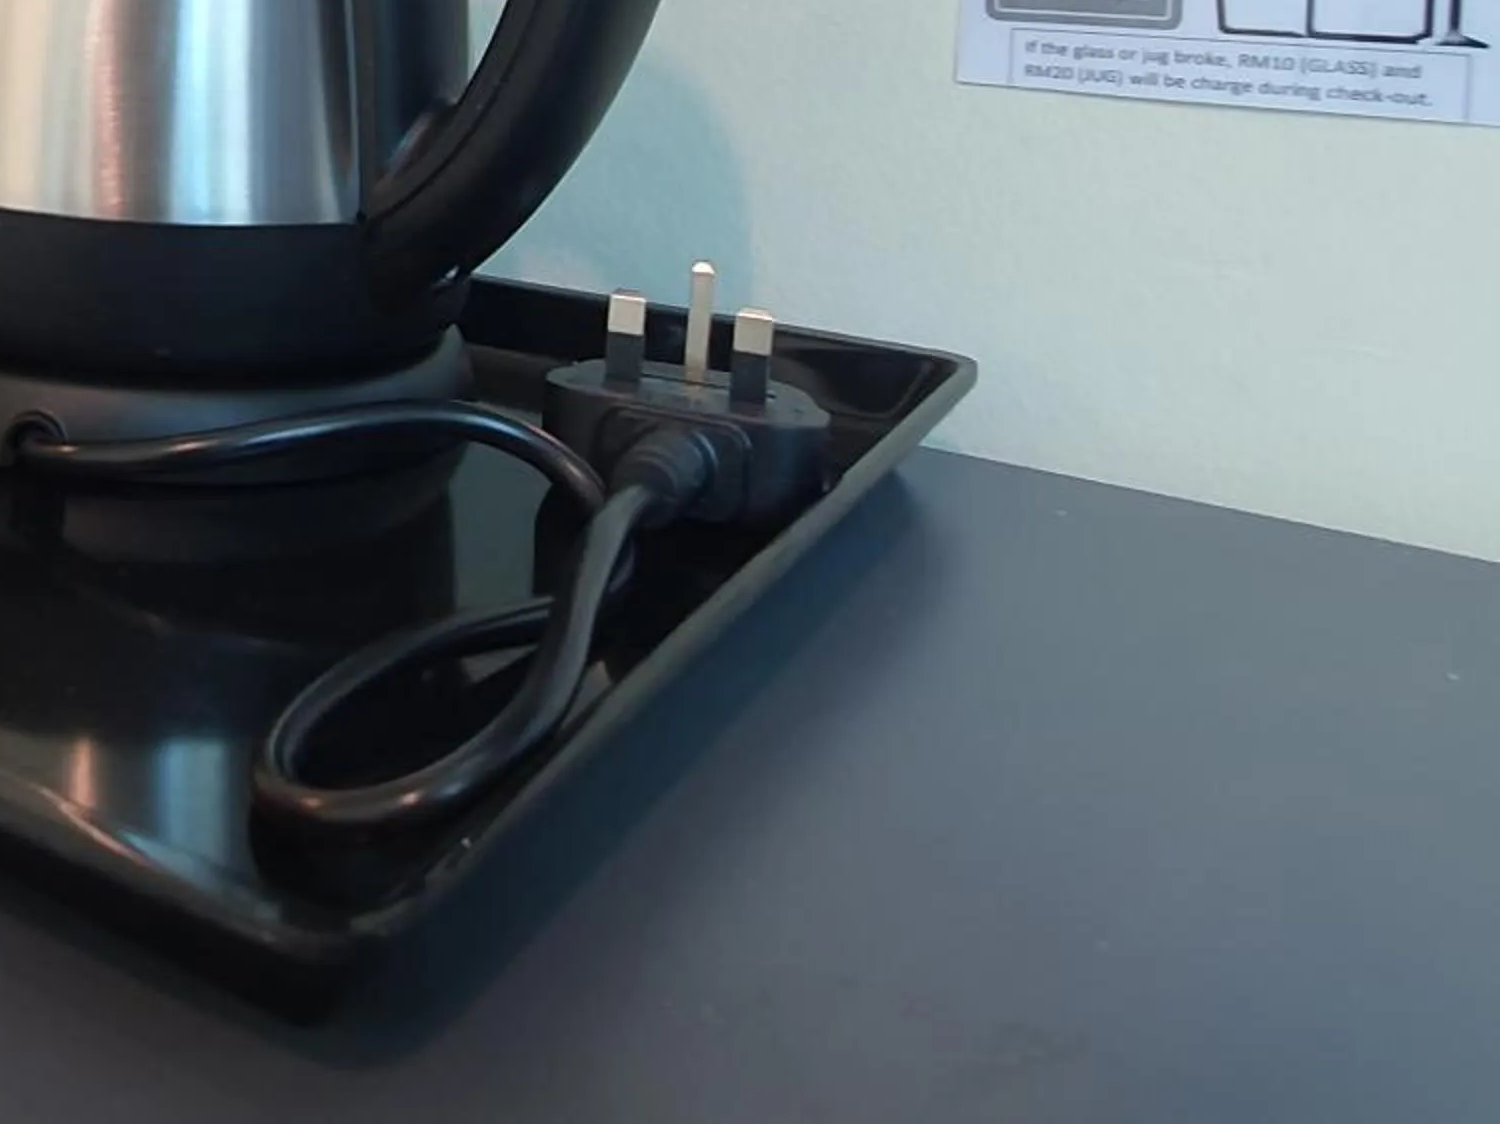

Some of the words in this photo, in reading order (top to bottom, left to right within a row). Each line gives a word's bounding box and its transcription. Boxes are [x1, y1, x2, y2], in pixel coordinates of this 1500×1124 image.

[1041, 42, 1068, 57] the
[1073, 44, 1114, 61] glass
[1117, 48, 1139, 61] or
[1142, 49, 1171, 66] jug
[1237, 53, 1295, 72] RM10
[1382, 63, 1423, 79] and
[1024, 63, 1074, 80] RM20
[1130, 71, 1160, 87] will
[1164, 74, 1187, 89] be
[1191, 76, 1253, 97] charge
[1258, 81, 1322, 102] during
